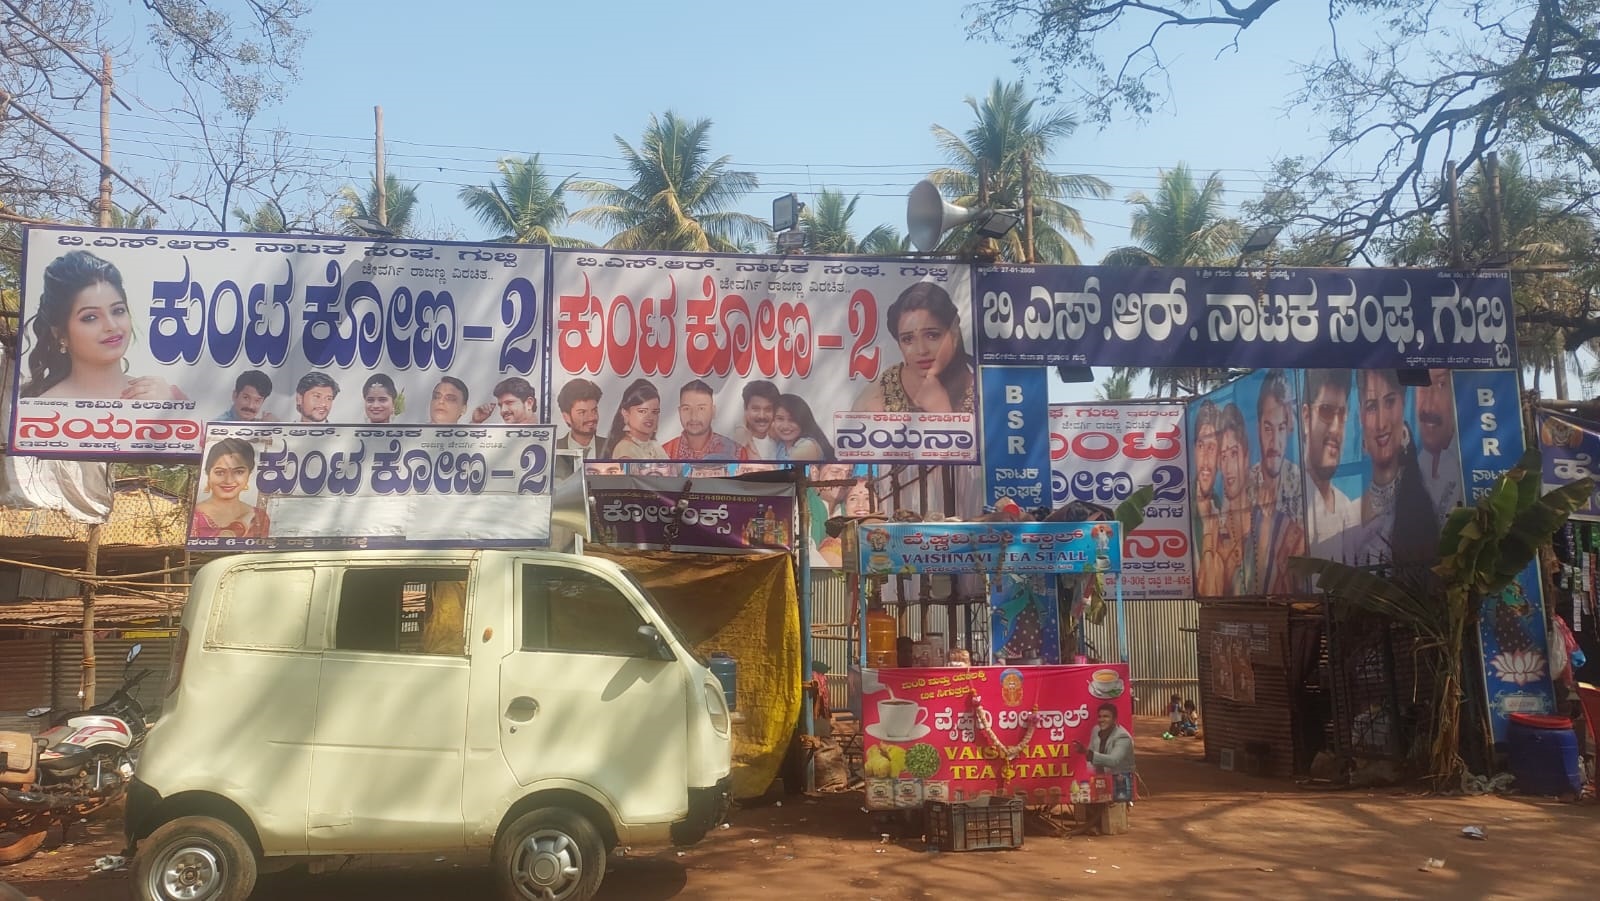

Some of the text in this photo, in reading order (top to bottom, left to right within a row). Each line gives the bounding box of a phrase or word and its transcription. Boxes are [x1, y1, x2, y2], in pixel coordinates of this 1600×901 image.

[255, 242, 346, 255] ನಾಟಕ
[736, 262, 809, 273] ನಾಟಕ
[149, 255, 295, 367] ಕುಂಟ
[1206, 278, 1319, 343] ನಾಟಕ
[557, 271, 677, 377] ಕುಂಟ
[75, 400, 123, 409] ಕಾಮಿಡಿ
[131, 400, 197, 411] ಕಿಲಾಡಿಗಳ
[19, 411, 200, 441] ನಯನಾ
[354, 429, 423, 438] ನಾಟಕ
[837, 422, 974, 449] ನಯನಾ
[19, 440, 69, 448] ಇವರು
[256, 438, 367, 496] ಕುಂಟ
[995, 468, 1039, 481] ನಾಟಕ
[1142, 505, 1184, 518] ಡಿಗಳ
[187, 536, 219, 546] ಸಂಜೆ
[903, 532, 970, 551] ವೈಷ್ಣವಿ
[902, 552, 992, 564] VAISHNAVI
[1031, 551, 1089, 562] STALL
[944, 743, 1070, 760] VAISNAVI
[950, 765, 997, 780] TEA
